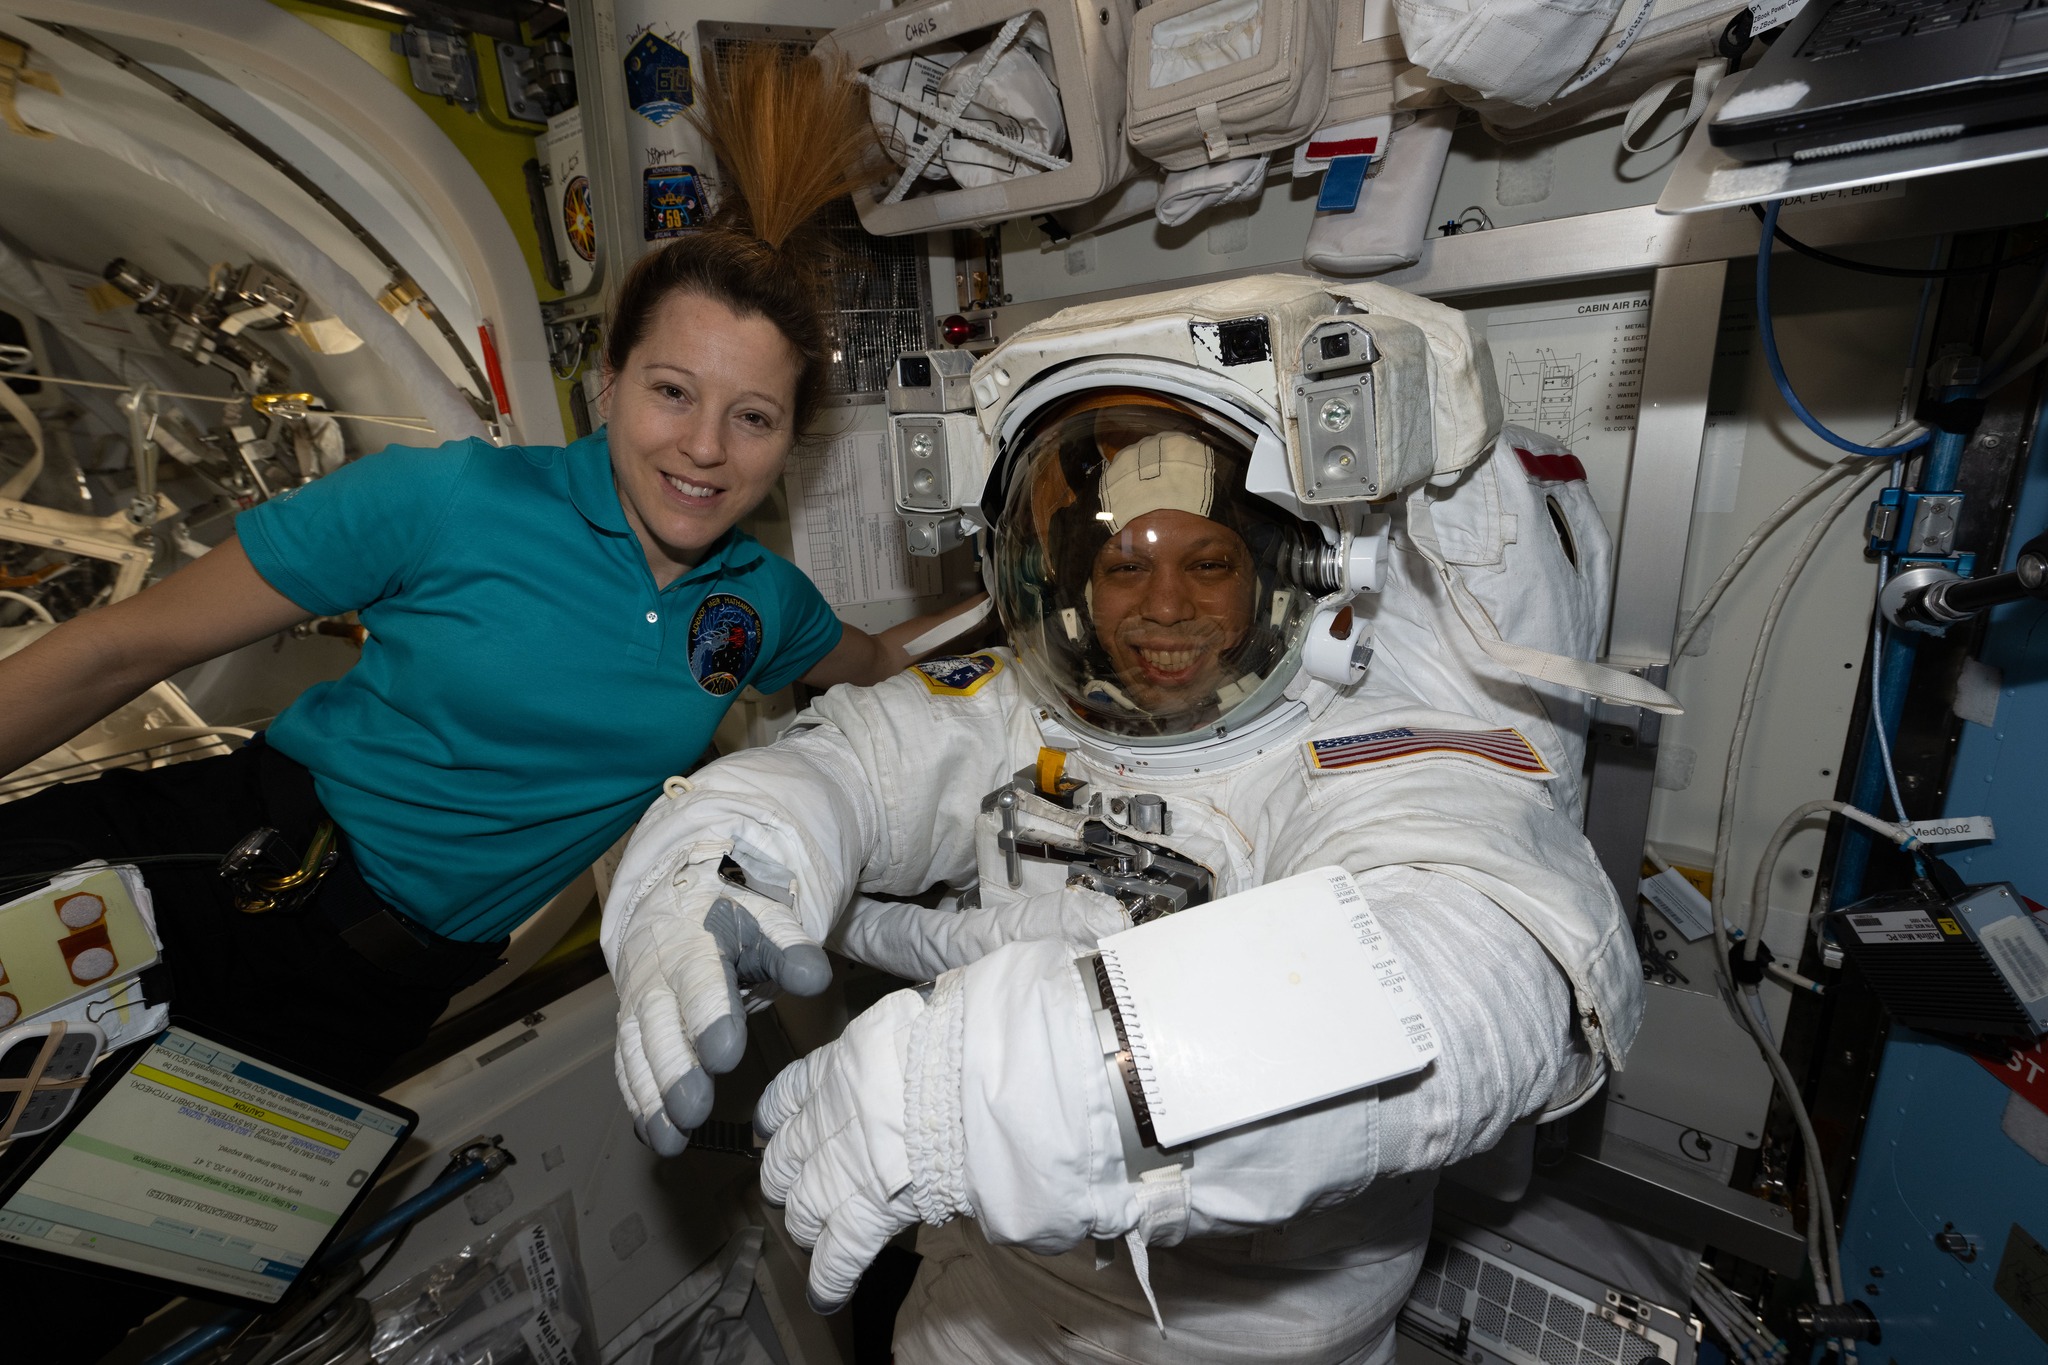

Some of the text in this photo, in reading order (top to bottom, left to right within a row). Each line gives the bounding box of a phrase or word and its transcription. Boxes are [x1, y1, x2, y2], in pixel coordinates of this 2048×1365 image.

[1750, 4, 1762, 13] P1
[1754, 3, 1787, 23] ZBook Power
[905, 18, 937, 40] CHRIS
[1760, 17, 1777, 29] ZBook
[703, 203, 713, 221] KOC
[666, 209, 682, 228] 59
[1578, 303, 1609, 313] CABIN
[1612, 301, 1629, 310] AIR
[1912, 824, 1971, 836] MedOps02
[1336, 889, 1356, 898] DRIVE
[1351, 912, 1369, 922] HING
[1916, 932, 1940, 940] Adlink
[1372, 958, 1396, 970] HATCH
[1380, 975, 1406, 988] HATCH
[1393, 986, 1403, 994] EV
[1400, 1013, 1423, 1025] MSGS
[1405, 1023, 1425, 1033] MISC
[1410, 1032, 1432, 1044] LIGHT
[153, 1046, 173, 1058] hook
[1416, 1042, 1434, 1052] BITE
[171, 1053, 191, 1064] SCU
[188, 1059, 224, 1077] integrated
[220, 1072, 235, 1081] The
[251, 1084, 268, 1094] SCU
[266, 1090, 278, 1098] the
[161, 1061, 356, 1138] SCU bend radius and tension into the SCU-DCM interface should be
[170, 1095, 209, 1112] ON-ORBIT
[283, 1095, 310, 1109] damage
[177, 1106, 204, 1120] SIZING
[232, 1102, 265, 1117] CAUTION
[306, 1104, 330, 1117] prevent
[202, 1115, 237, 1131] NOMINAL
[242, 1120, 257, 1129] EVA
[252, 1131, 287, 1148] performing
[284, 1143, 295, 1151] by
[240, 1152, 255, 1161] has
[298, 1149, 315, 1158] EMU
[313, 1154, 335, 1165] Assess
[169, 1166, 204, 1181] privatized
[268, 1162, 291, 1174] minute
[201, 1174, 223, 1186] setup
[243, 1172, 263, 1183] (ATU
[260, 1178, 276, 1187] ATU
[296, 1171, 316, 1182] When
[226, 1184, 246, 1194] MCC
[243, 1190, 257, 1198] call
[285, 1185, 305, 1196] Verify
[269, 1196, 286, 1206] Step
[143, 1188, 278, 1231] FITCHECK VERIFICATION (15 MINUTES)
[532, 1225, 551, 1264] Waist
[496, 1277, 514, 1300] aist
[536, 1310, 561, 1348] Waist
